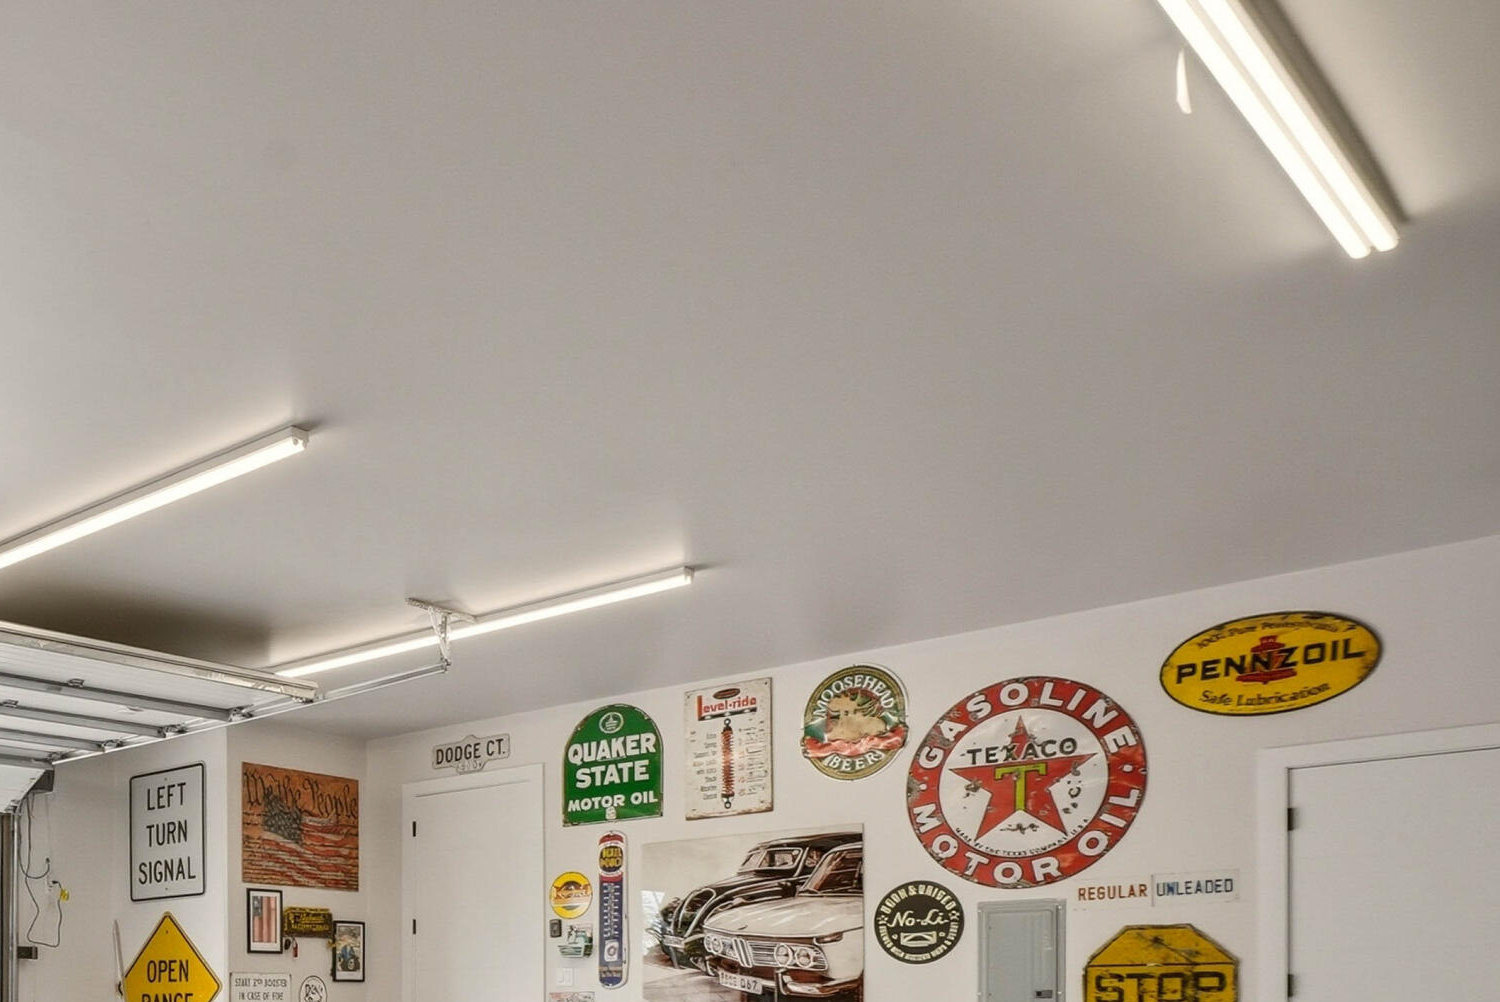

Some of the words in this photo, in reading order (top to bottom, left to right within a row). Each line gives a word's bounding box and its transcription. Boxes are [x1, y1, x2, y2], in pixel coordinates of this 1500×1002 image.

[1176, 638, 1367, 684] PENNZOIL
[813, 675, 895, 719] MOOSEHEAD
[1200, 690, 1232, 706] Safe
[918, 681, 1138, 770] GASOLINE
[436, 742, 481, 765] DODGE
[568, 732, 656, 765] QUAKER
[825, 750, 885, 770] BEER
[966, 737, 1078, 765] TEXACO
[576, 760, 649, 788] STATE
[147, 782, 186, 811] LEFT
[302, 777, 358, 821] People
[568, 794, 626, 812] MOTOR
[630, 790, 658, 805] OIL
[146, 819, 188, 848] TURN
[913, 803, 1063, 884] MOTOR
[1077, 788, 1142, 857] OIL
[138, 856, 196, 885] SIGNAL
[1078, 884, 1148, 901] REGULAR
[1156, 878, 1234, 896] UNLEADED
[147, 959, 189, 983] OPEN
